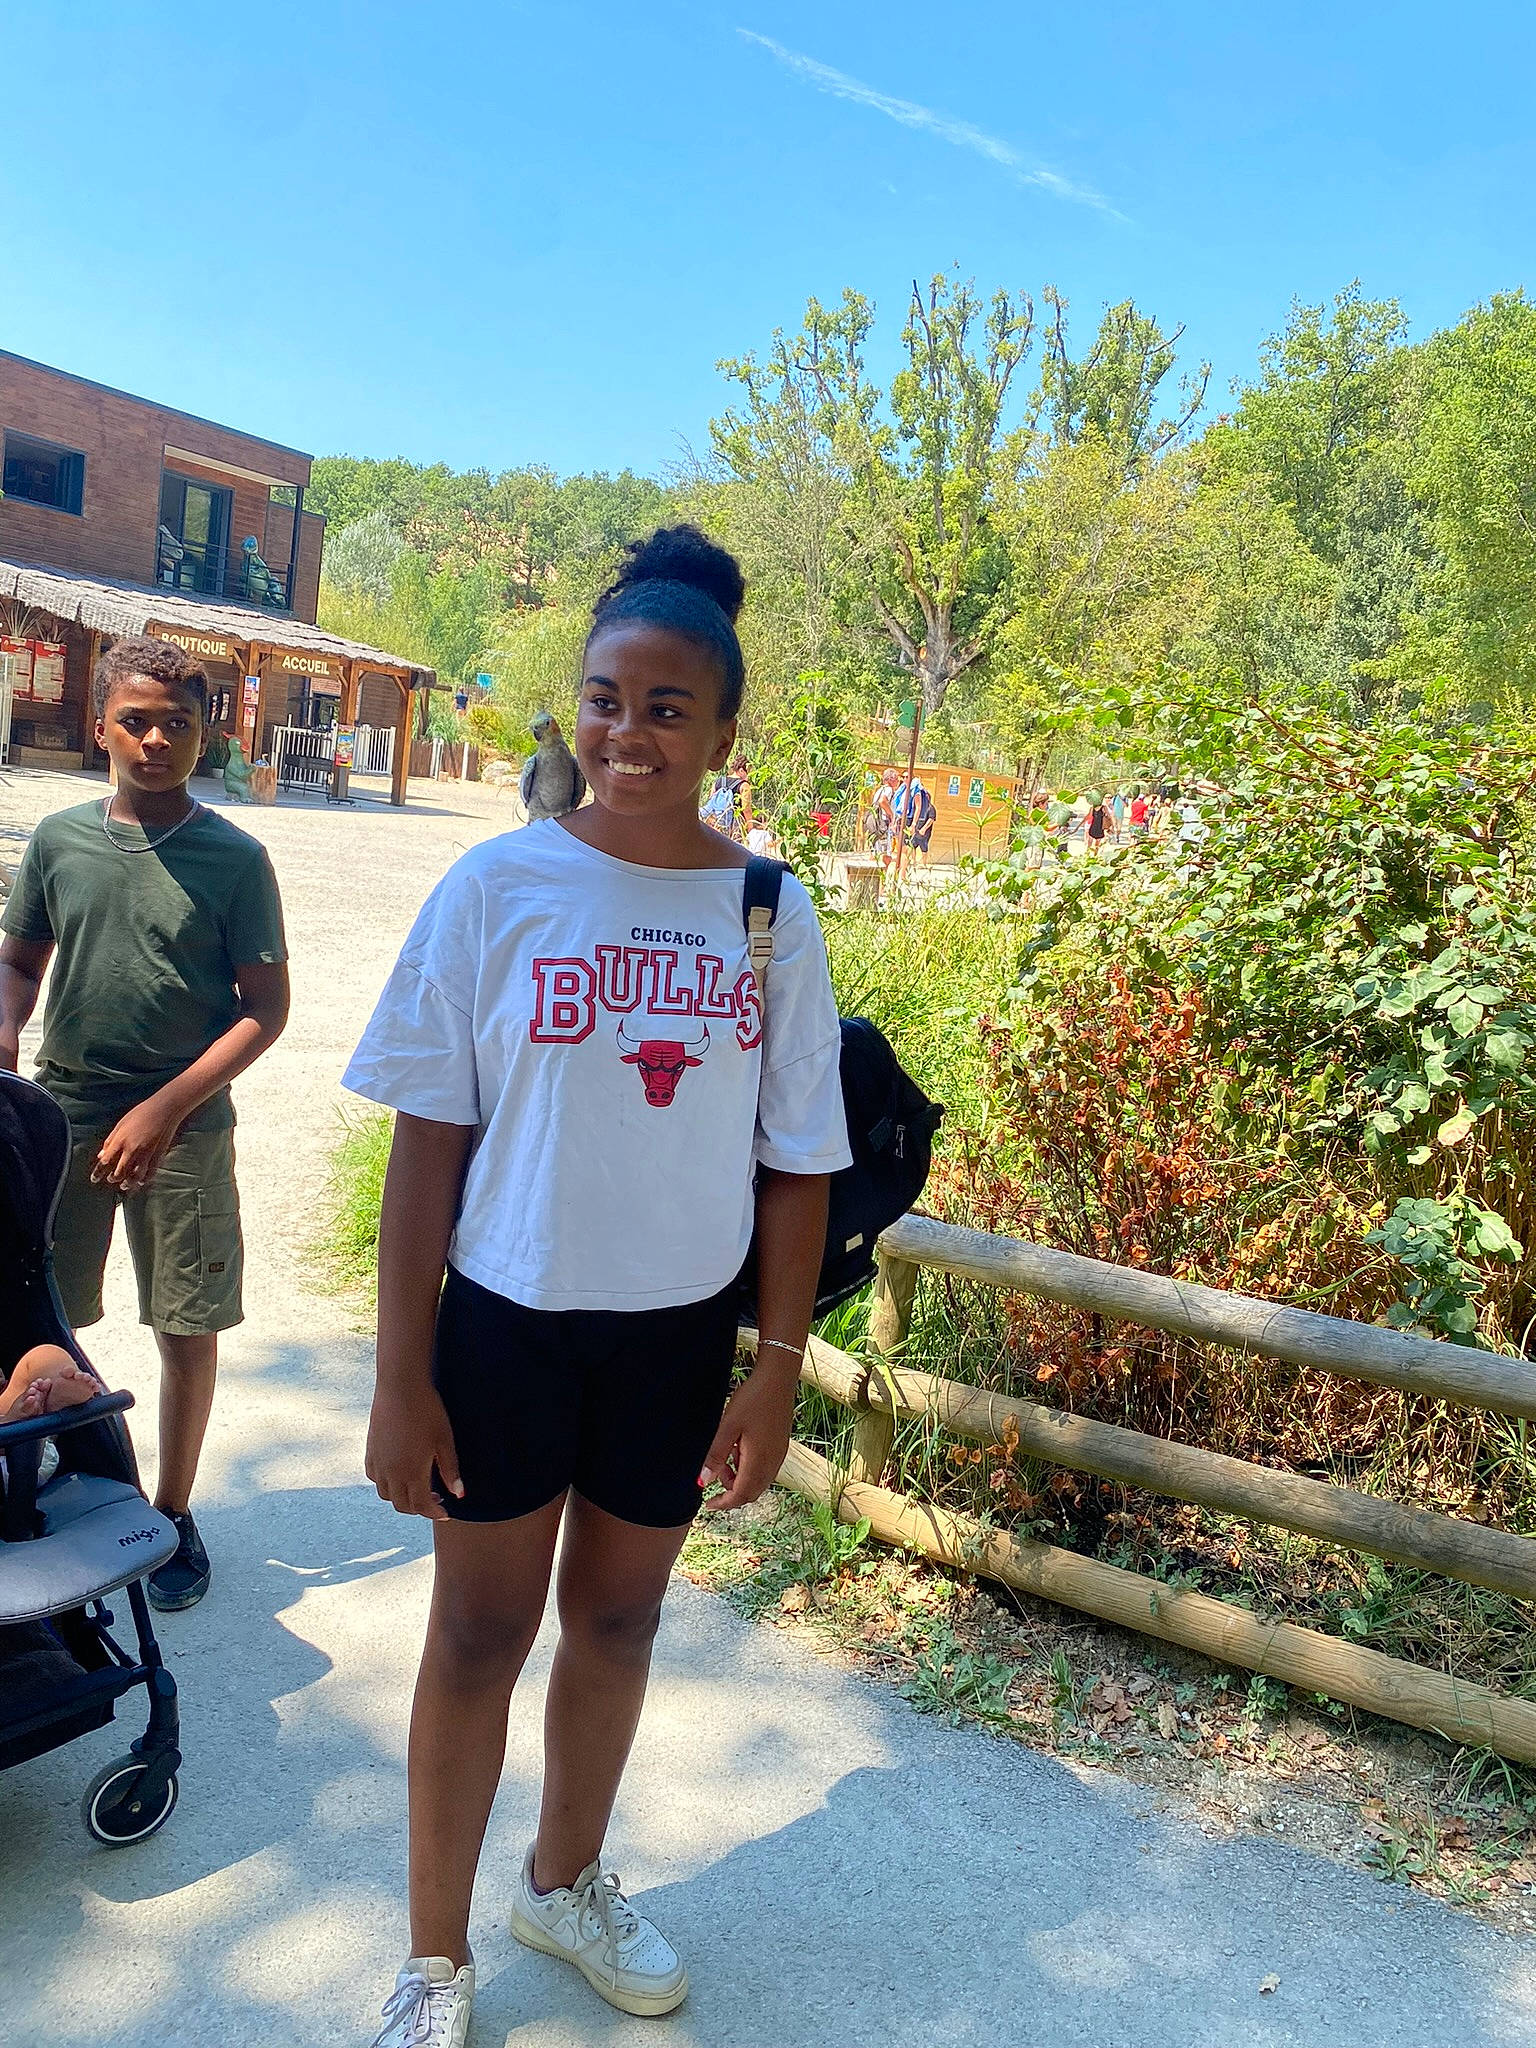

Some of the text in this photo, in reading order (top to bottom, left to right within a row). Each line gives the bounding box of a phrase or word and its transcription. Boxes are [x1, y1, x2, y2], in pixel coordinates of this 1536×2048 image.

[281, 655, 330, 675] ACCUEIL
[631, 926, 706, 947] CHICAGO
[529, 944, 762, 1051] BULLS
[118, 1526, 161, 1547] migo
